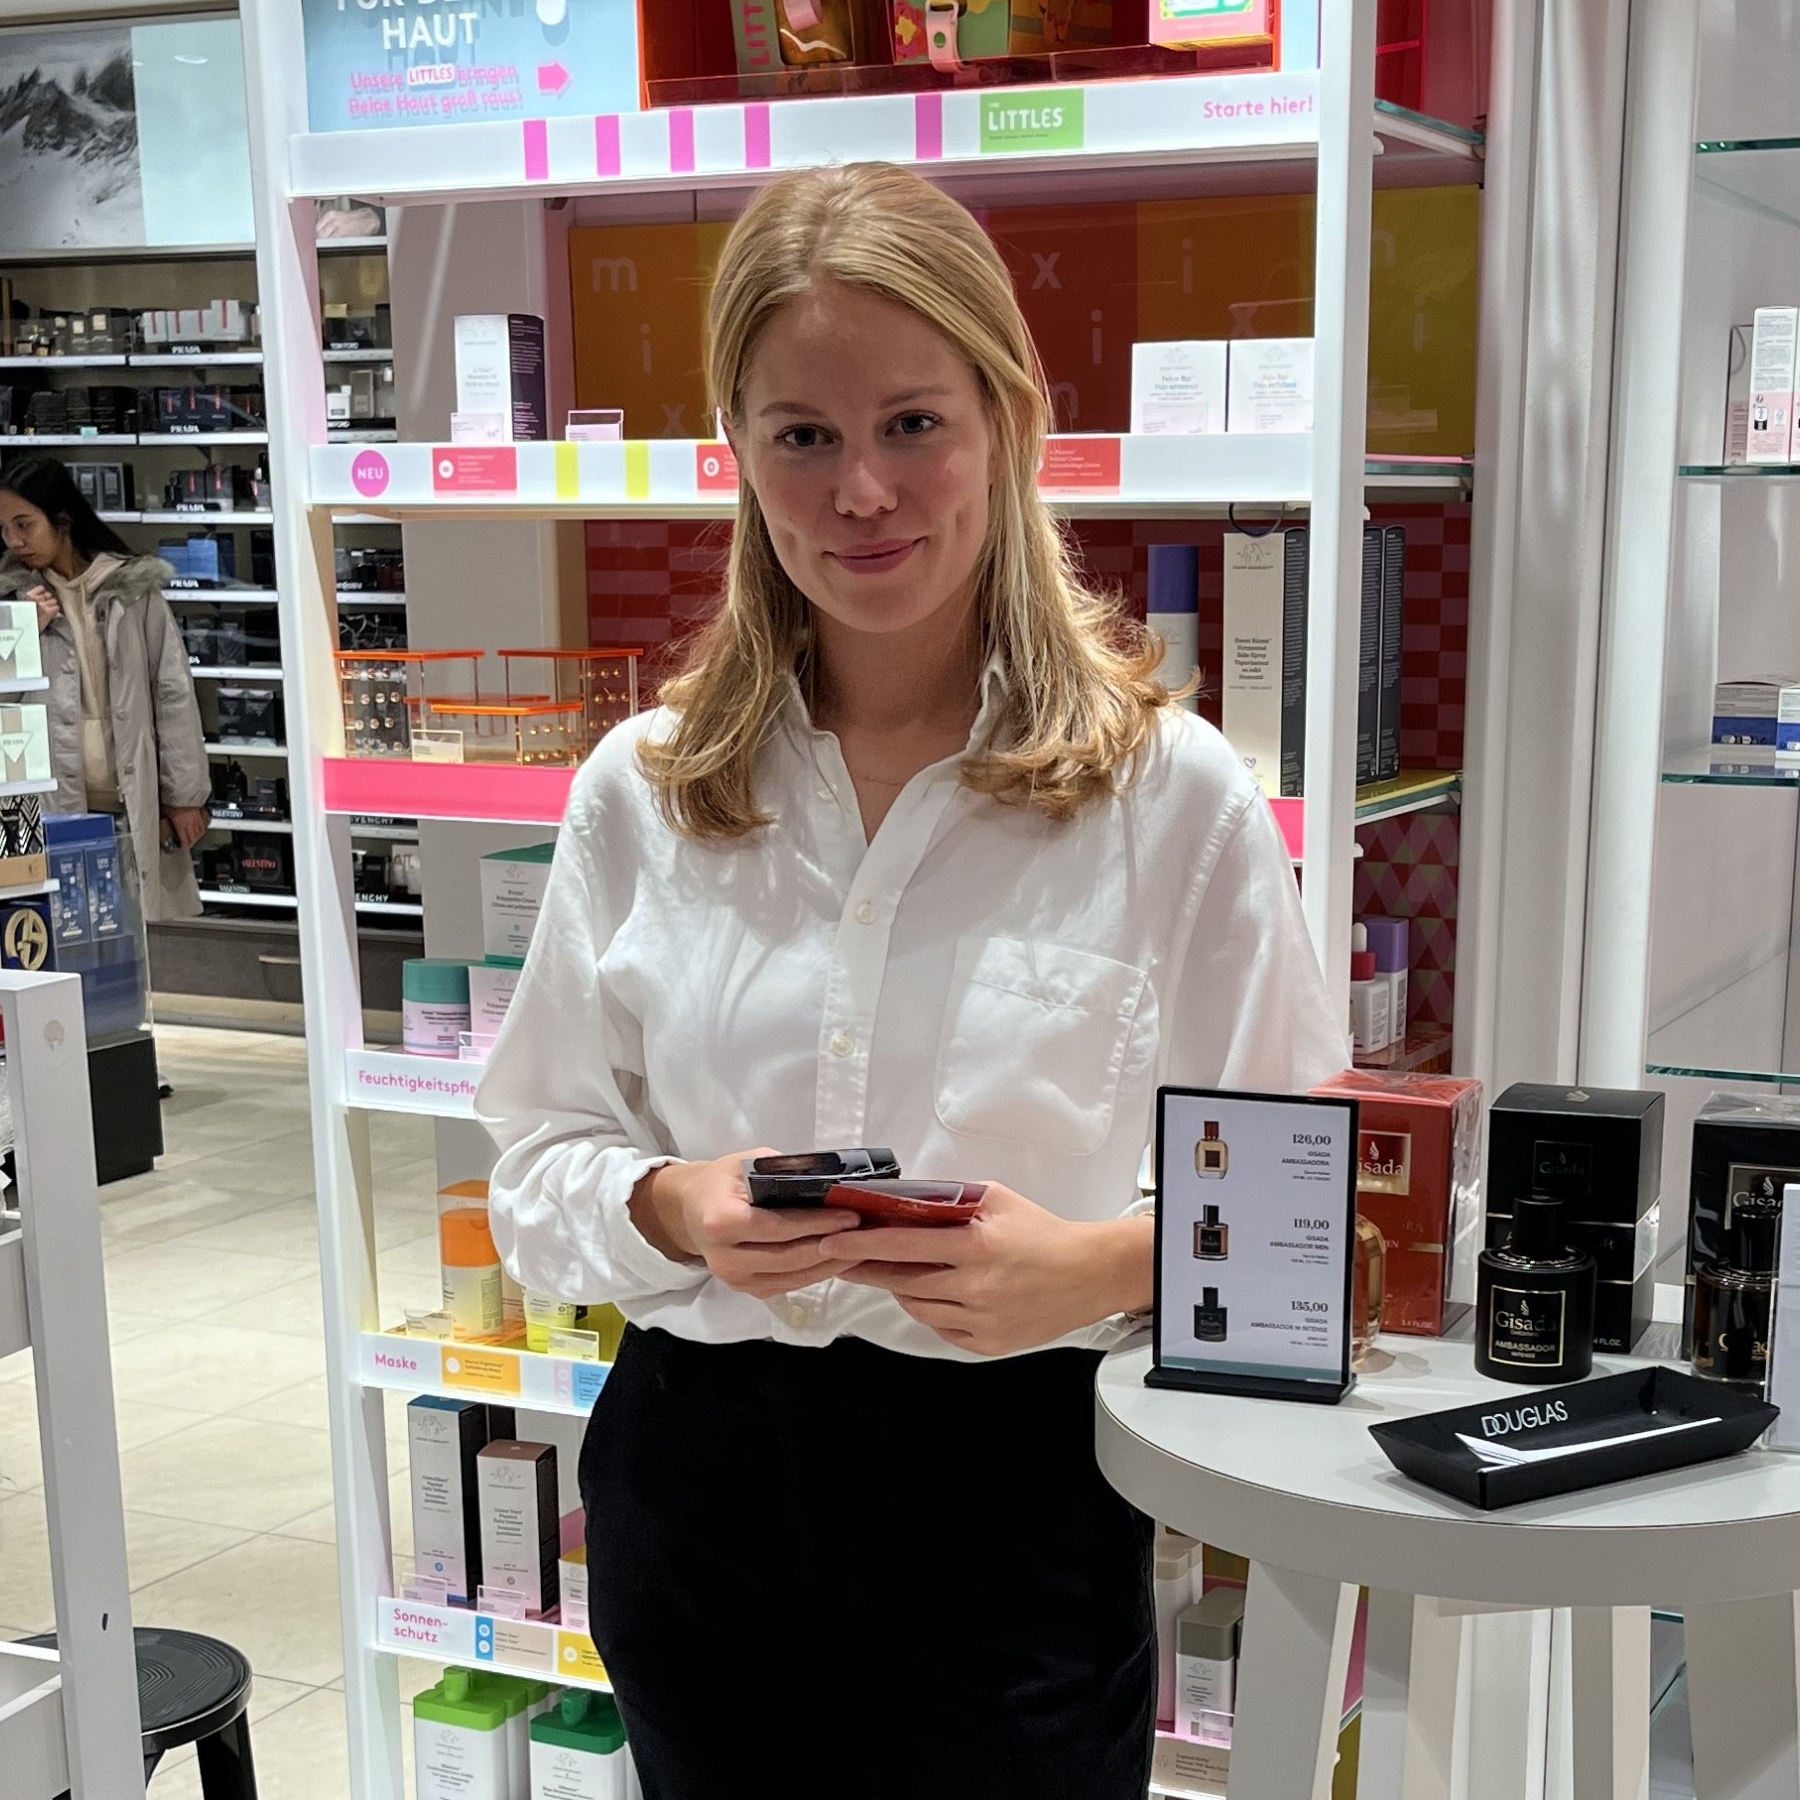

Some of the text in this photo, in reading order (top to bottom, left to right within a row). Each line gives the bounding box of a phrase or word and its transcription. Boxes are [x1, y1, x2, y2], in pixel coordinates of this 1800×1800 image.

[382, 12, 478, 50] HAUT
[350, 65, 518, 90] Unsere LITTLES bringen
[349, 96, 391, 115] Deine
[396, 94, 436, 111] Haut
[1203, 94, 1314, 118] Starte hier!
[988, 106, 1063, 131] LITTLES
[357, 467, 384, 480] NEU
[1292, 1133, 1331, 1146] 126,00
[1294, 1218, 1330, 1231] 119,00
[1269, 1241, 1313, 1249] AMBASSADOR
[1291, 1300, 1329, 1313] 135,00
[1495, 1310, 1557, 1331] Gisada
[1495, 1340, 1556, 1352] AMBASSADOR
[374, 1353, 417, 1371] Maske
[1481, 1400, 1569, 1437] DOUGLAS
[393, 1608, 448, 1628] Sonnen-
[394, 1626, 439, 1643] schutz
